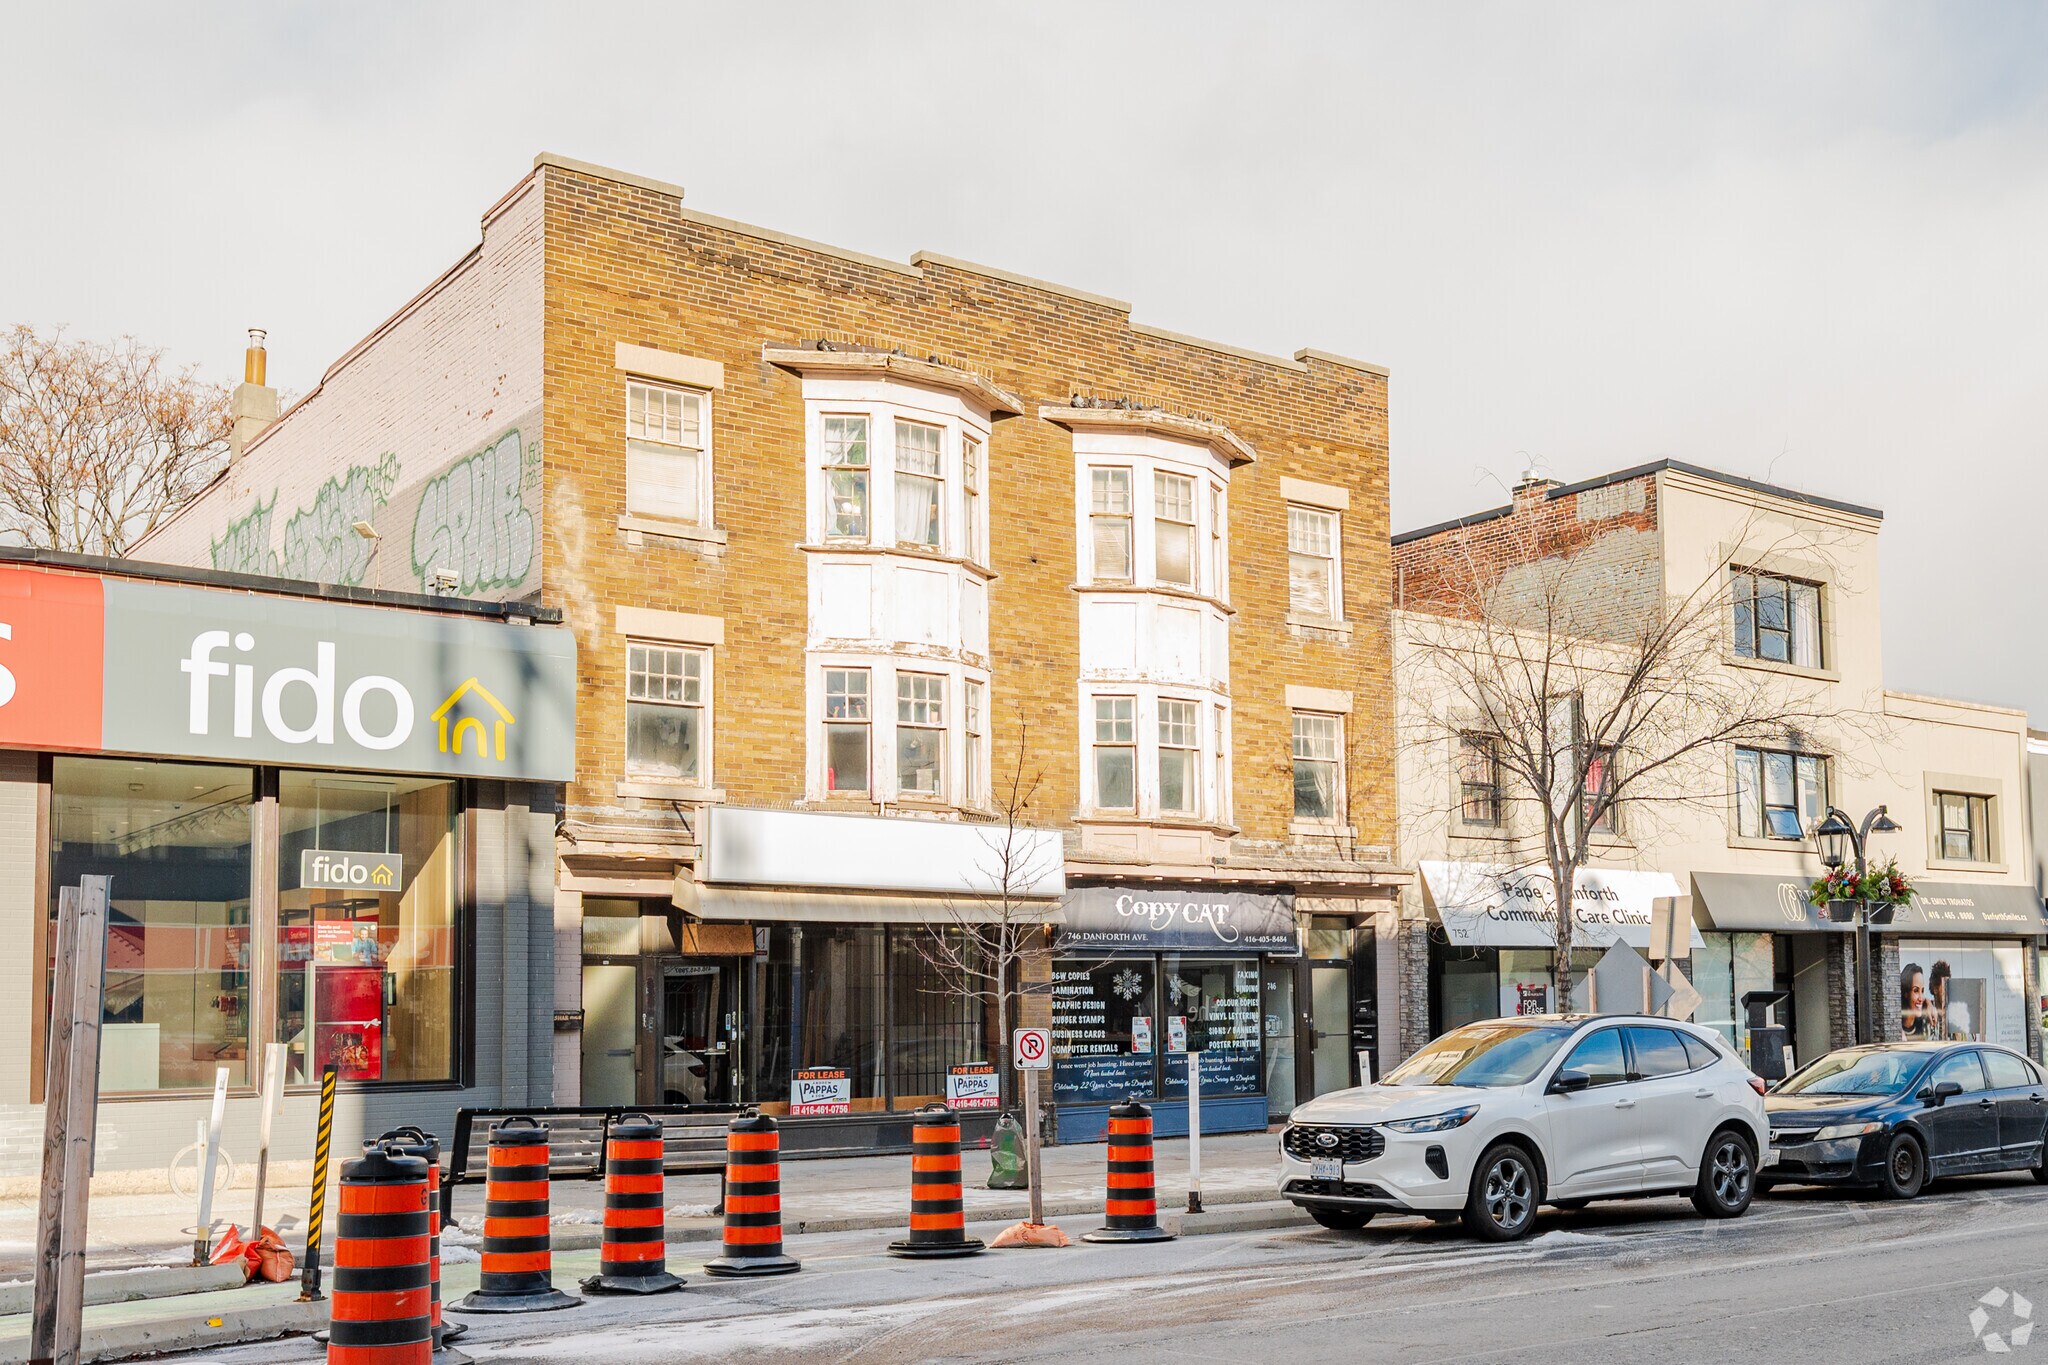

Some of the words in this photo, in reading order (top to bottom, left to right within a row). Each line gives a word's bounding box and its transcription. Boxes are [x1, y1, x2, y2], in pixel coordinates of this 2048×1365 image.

[181, 630, 415, 750] fido
[312, 855, 368, 884] fido
[1502, 882, 1542, 900] Pape
[1572, 884, 1619, 901] nforth
[1115, 895, 1181, 931] Copy
[1182, 903, 1239, 943] CAT
[1486, 905, 1558, 923] Communi
[1576, 908, 1610, 924] Care
[1612, 909, 1652, 925] Clinic
[1067, 932, 1081, 940] 746
[1083, 932, 1130, 941] DANFORTH
[1131, 933, 1149, 941] AVE.
[1452, 929, 1469, 939] 752
[1244, 935, 1287, 943] 416-405-8484
[1068, 971, 1090, 980] COPIES
[1237, 970, 1259, 979] FAXING
[1052, 986, 1094, 995] LAMINATION
[1267, 982, 1277, 990] 746
[1052, 1001, 1082, 1010] GRAPHIC
[1082, 1001, 1106, 1010] DESIGN
[1216, 999, 1239, 1007] COLOUR
[1240, 998, 1259, 1007] COPIES
[1523, 1000, 1537, 1008] FOR
[1523, 1007, 1544, 1015] LEASE
[1052, 1016, 1078, 1024] RUBBER
[1078, 1015, 1106, 1024] STAMPS
[1209, 1012, 1227, 1021] VINYL
[1228, 1011, 1259, 1021] LETTERING
[1052, 1030, 1083, 1039] BUSINESS
[1084, 1030, 1106, 1038] CARDS
[1208, 1027, 1226, 1035] SIGNS
[1052, 1045, 1089, 1054] COMPUTER
[1089, 1044, 1118, 1053] RENTALS
[1208, 1041, 1231, 1049] POSTER
[1232, 1040, 1259, 1049] PRINTING
[969, 1066, 994, 1074] LEASE
[1087, 1062, 1097, 1070] job
[798, 1071, 816, 1079] FOR
[817, 1070, 845, 1079] LEASE
[957, 1078, 988, 1089] PAPPAS
[1080, 1081, 1089, 1090] 22
[803, 1083, 838, 1094] PAPPAS
[956, 1098, 998, 1108] 416-461-0756
[801, 1104, 848, 1115] 416-461-0756
